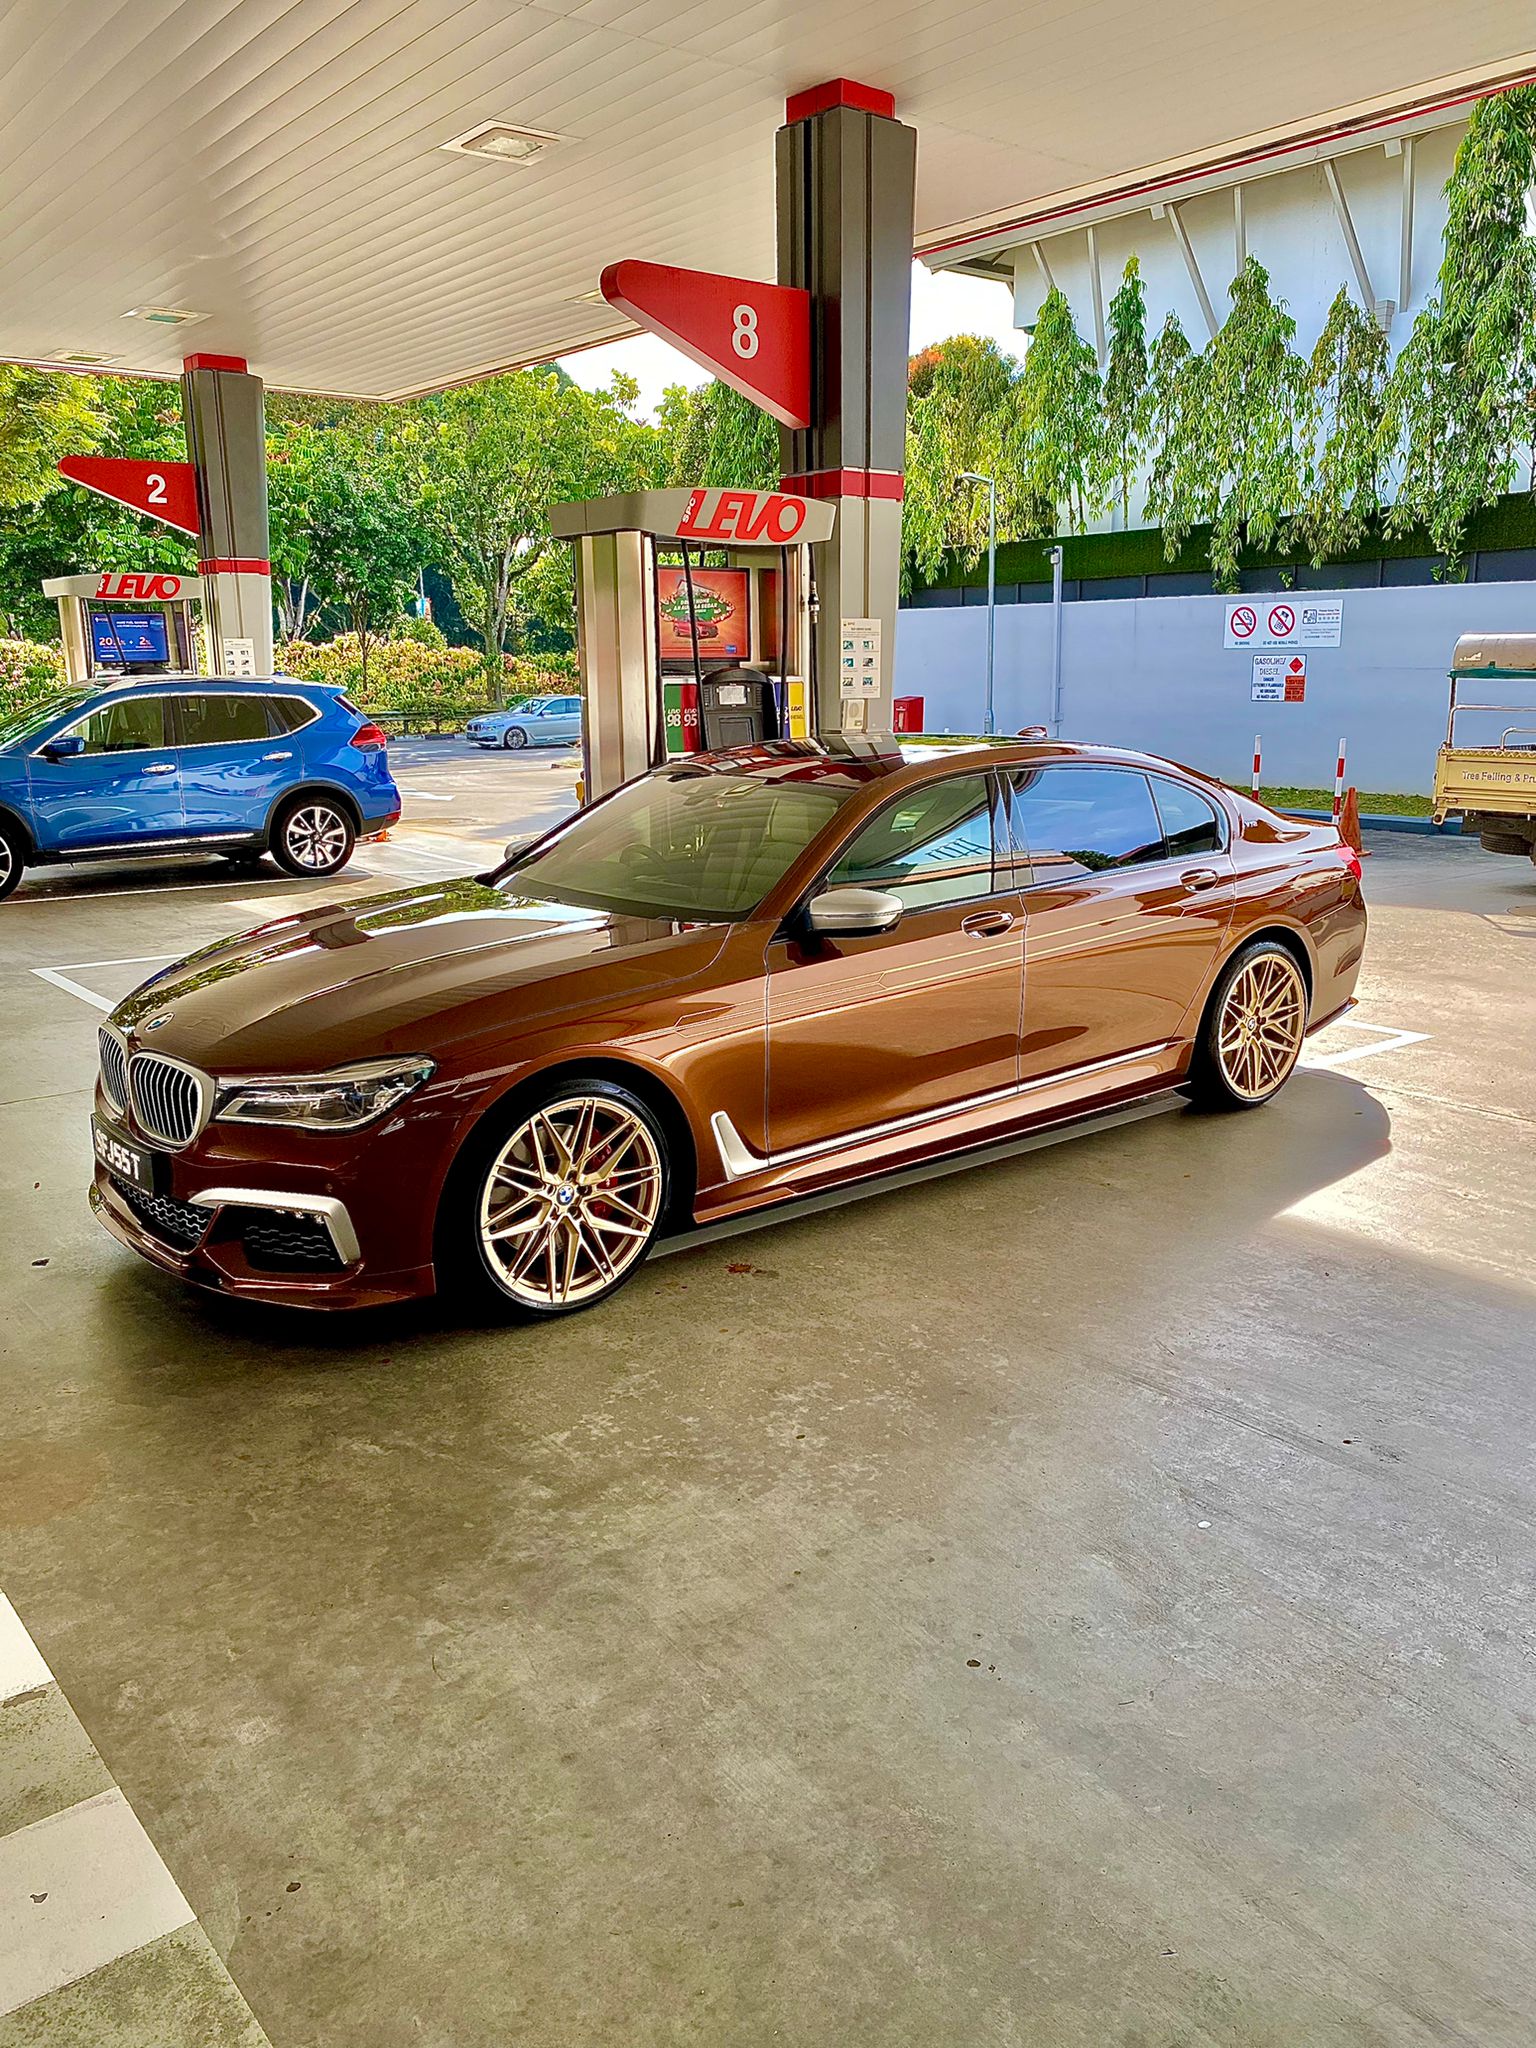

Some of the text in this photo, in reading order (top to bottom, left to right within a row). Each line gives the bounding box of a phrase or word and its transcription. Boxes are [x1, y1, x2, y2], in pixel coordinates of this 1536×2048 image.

[731, 304, 759, 359] 8
[146, 473, 168, 504] 2
[676, 489, 807, 543] LEVO
[682, 497, 697, 524] SPC
[95, 573, 182, 600] LEVO
[1259, 667, 1280, 675] DIESEL
[667, 714, 681, 727] 98
[684, 714, 698, 727] 95
[1462, 770, 1480, 780] Tree
[1481, 771, 1512, 783] Felling
[1514, 773, 1521, 782] &
